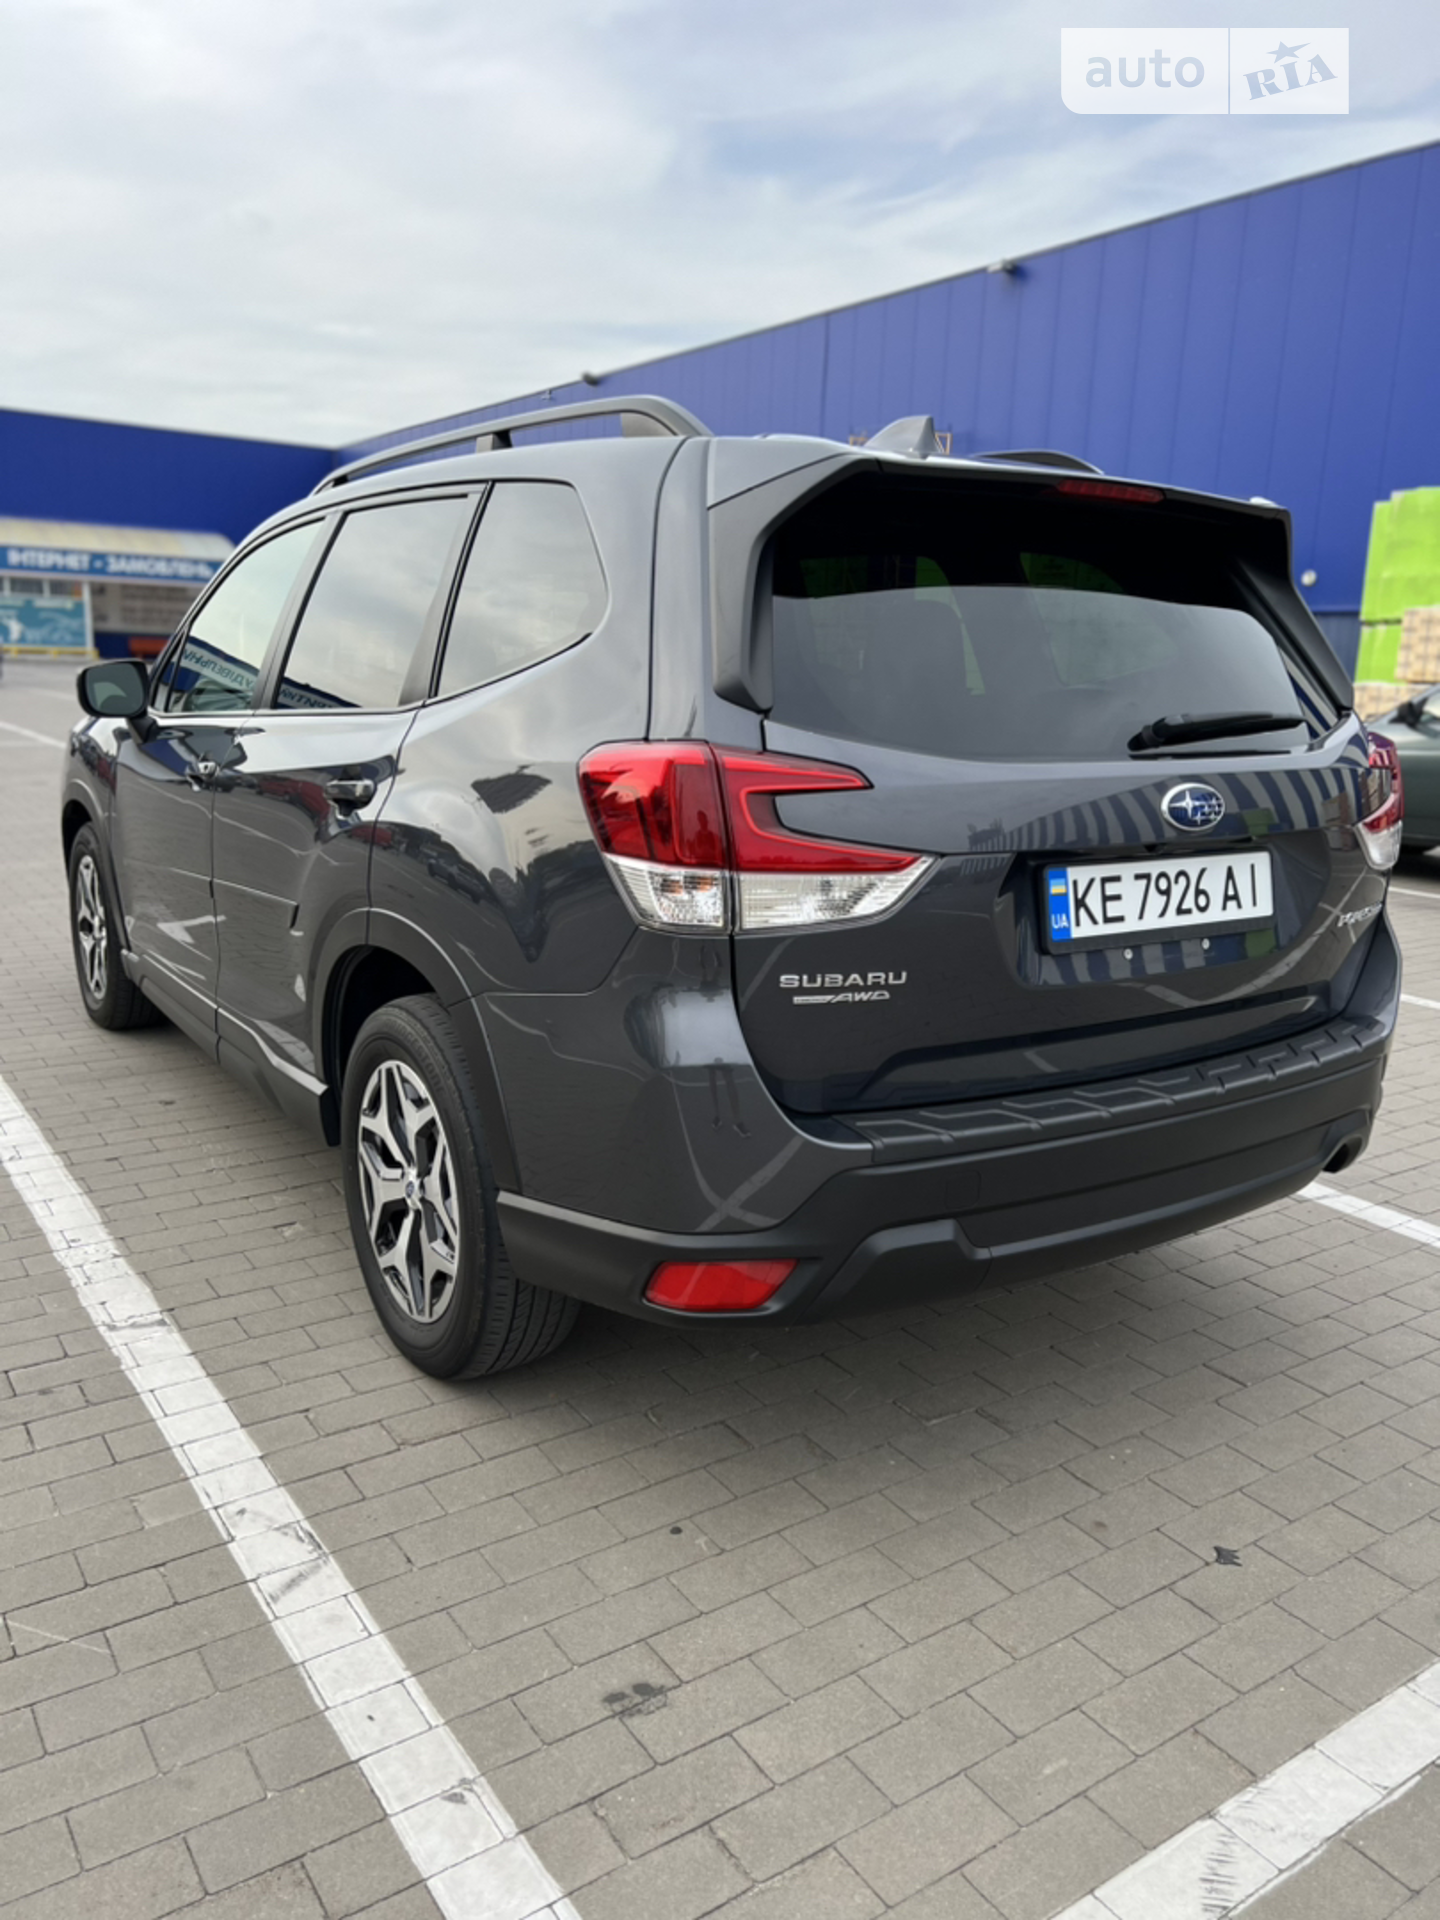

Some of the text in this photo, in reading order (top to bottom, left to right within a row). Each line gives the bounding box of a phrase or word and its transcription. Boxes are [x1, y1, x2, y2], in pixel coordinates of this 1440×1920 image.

[7, 549, 89, 571] ІНТЕРНЕТ
[1072, 863, 1257, 927] KE 7926 AI
[1051, 913, 1069, 930] UA
[779, 971, 907, 988] SUBARU
[830, 990, 890, 1004] AWD
